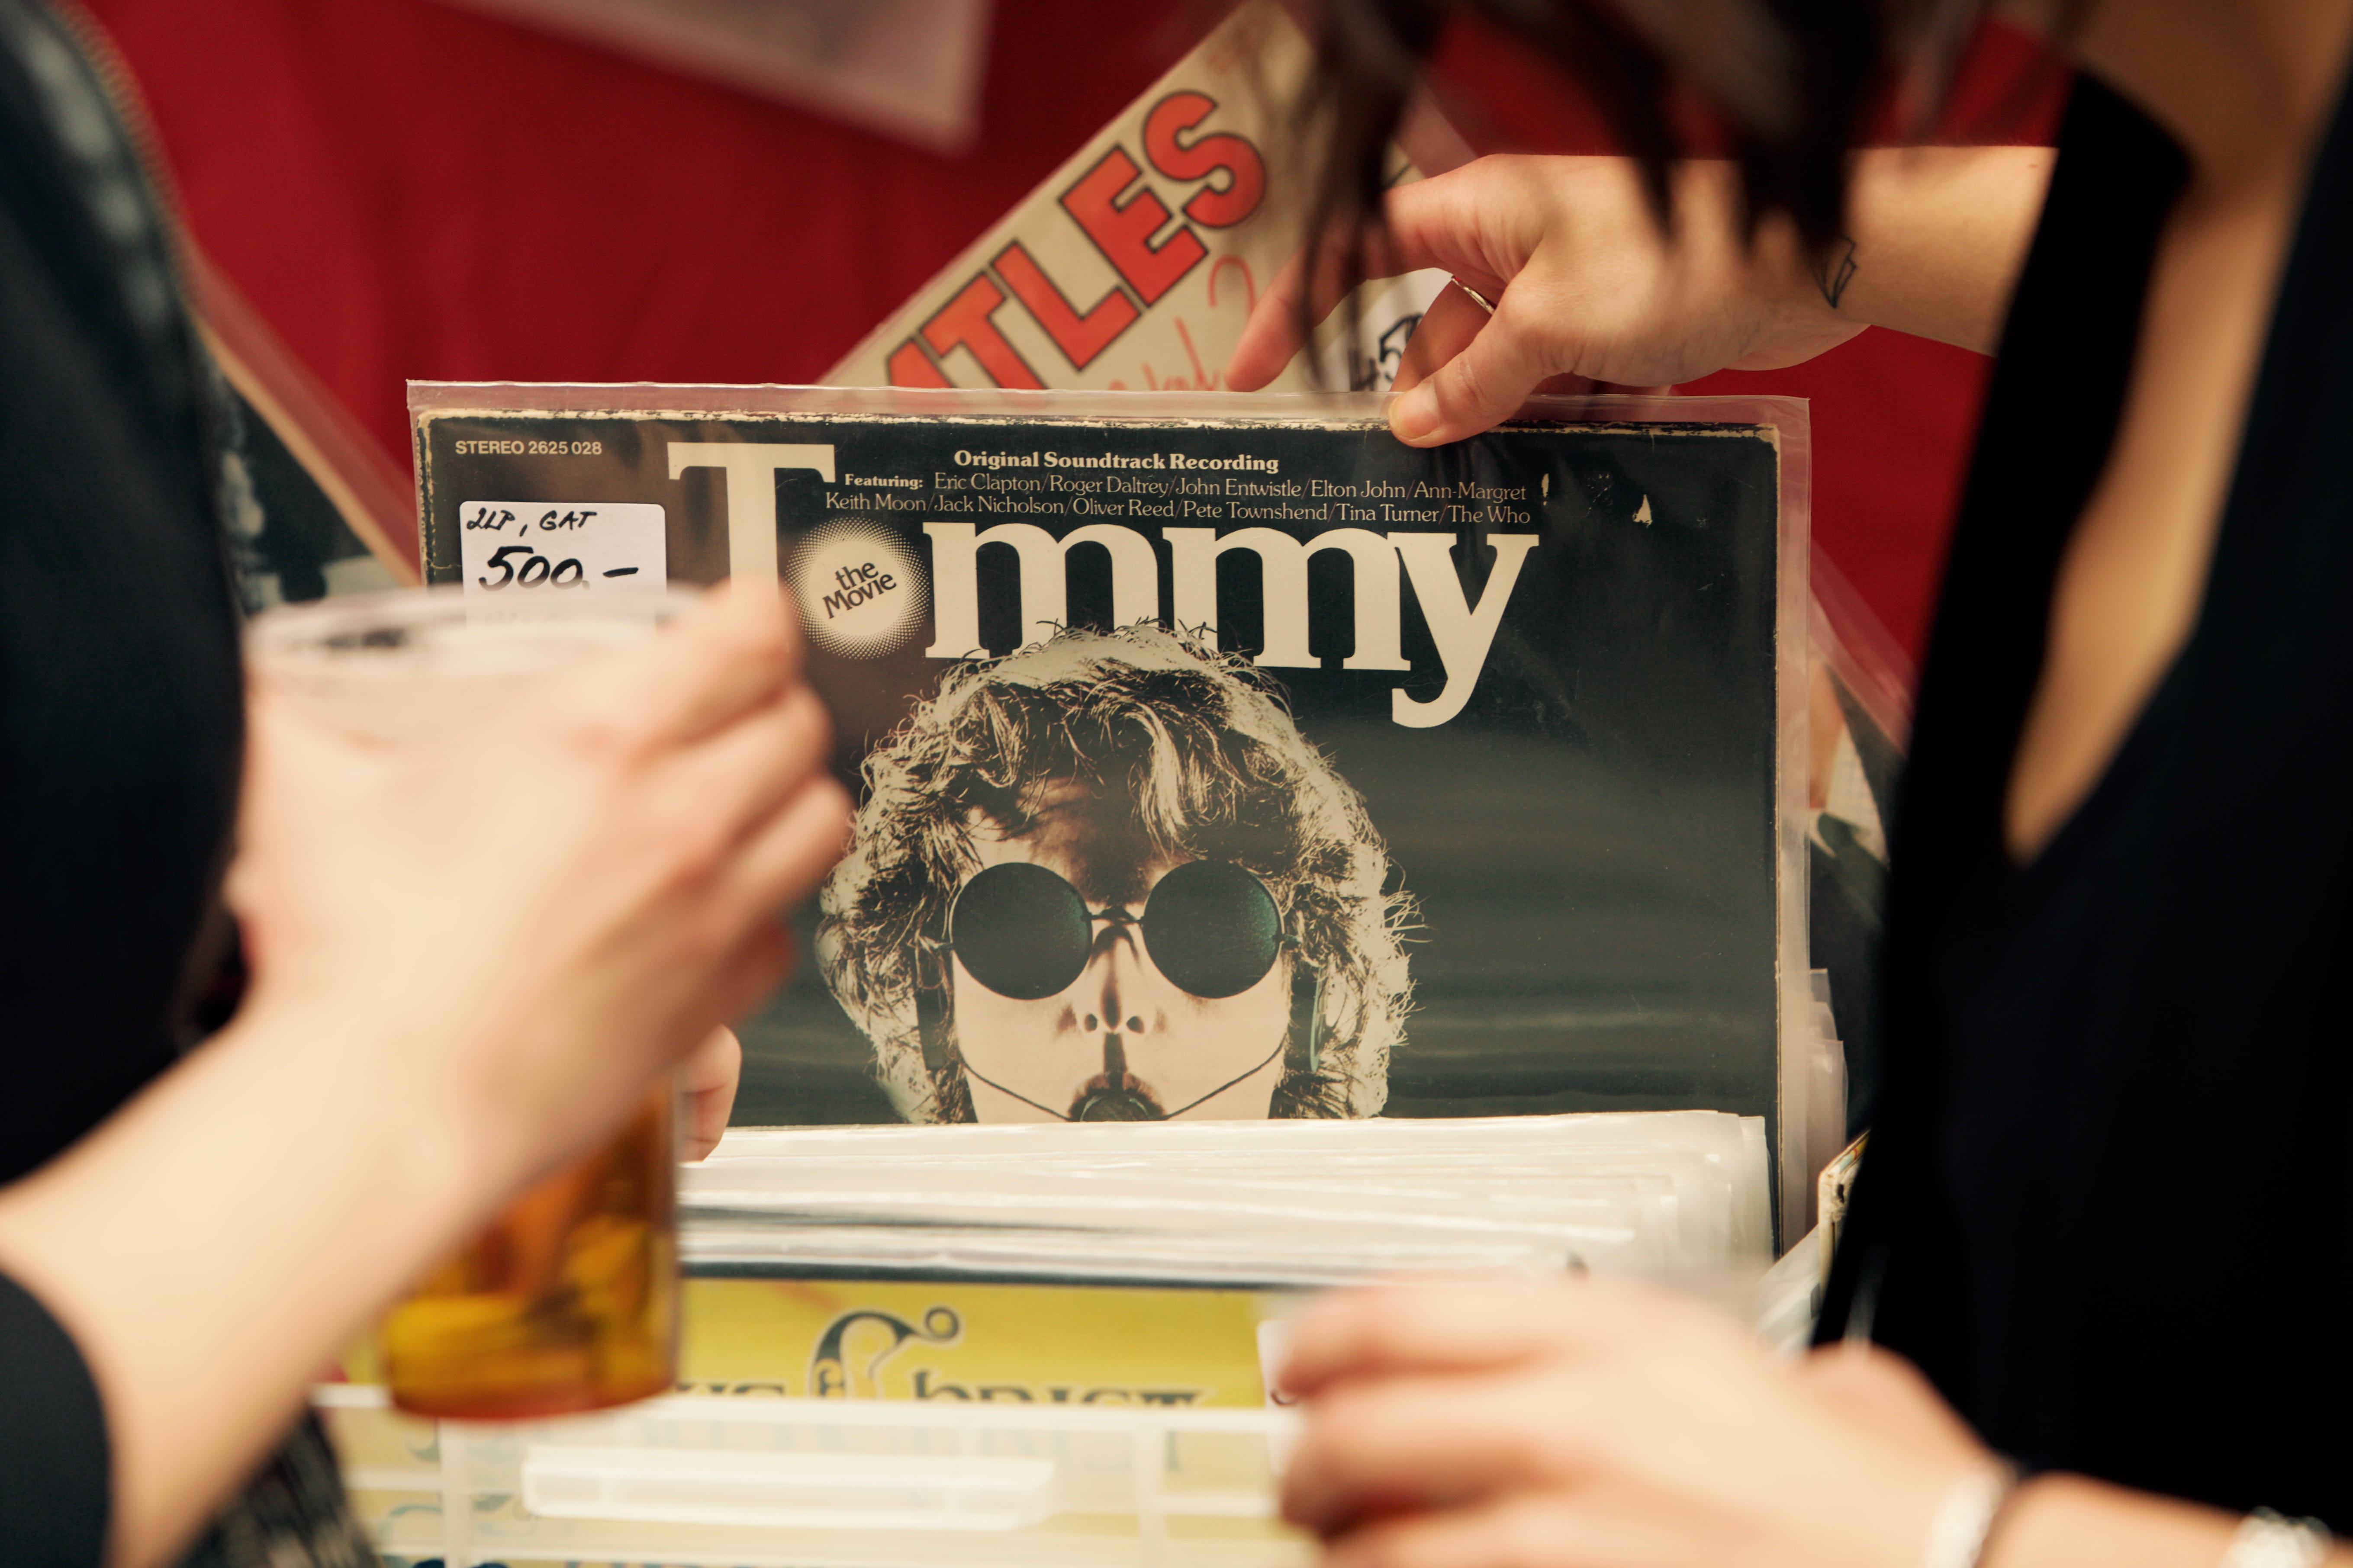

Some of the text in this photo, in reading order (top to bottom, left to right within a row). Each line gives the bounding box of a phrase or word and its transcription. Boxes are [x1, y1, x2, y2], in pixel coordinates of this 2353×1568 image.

[455, 440, 602, 456] STEREO 2625 028
[953, 450, 1279, 474] Original Soundtrack Recording
[845, 474, 923, 490] Featuring:
[935, 472, 967, 490] Eric
[826, 492, 870, 510] Keith
[1487, 506, 1531, 524] Who
[835, 562, 879, 591] the
[822, 574, 897, 620] Movie
